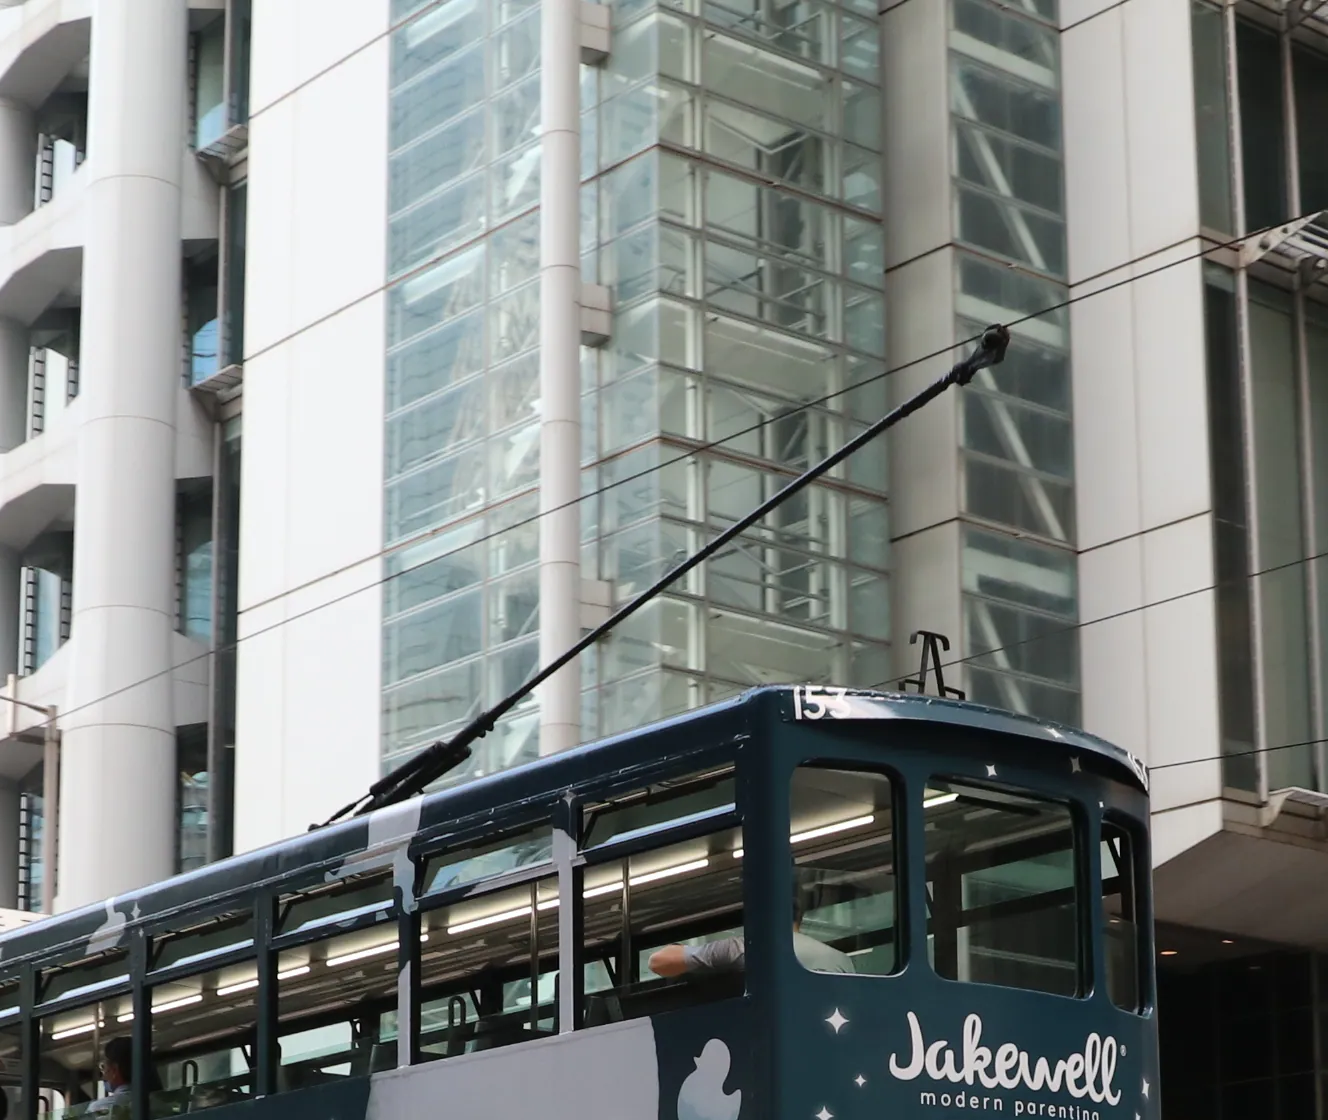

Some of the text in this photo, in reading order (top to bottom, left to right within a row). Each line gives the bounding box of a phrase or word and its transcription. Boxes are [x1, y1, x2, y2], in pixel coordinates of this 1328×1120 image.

[793, 685, 852, 720] 153
[889, 1011, 1122, 1106] Jakewell
[920, 1090, 1004, 1111] modern
